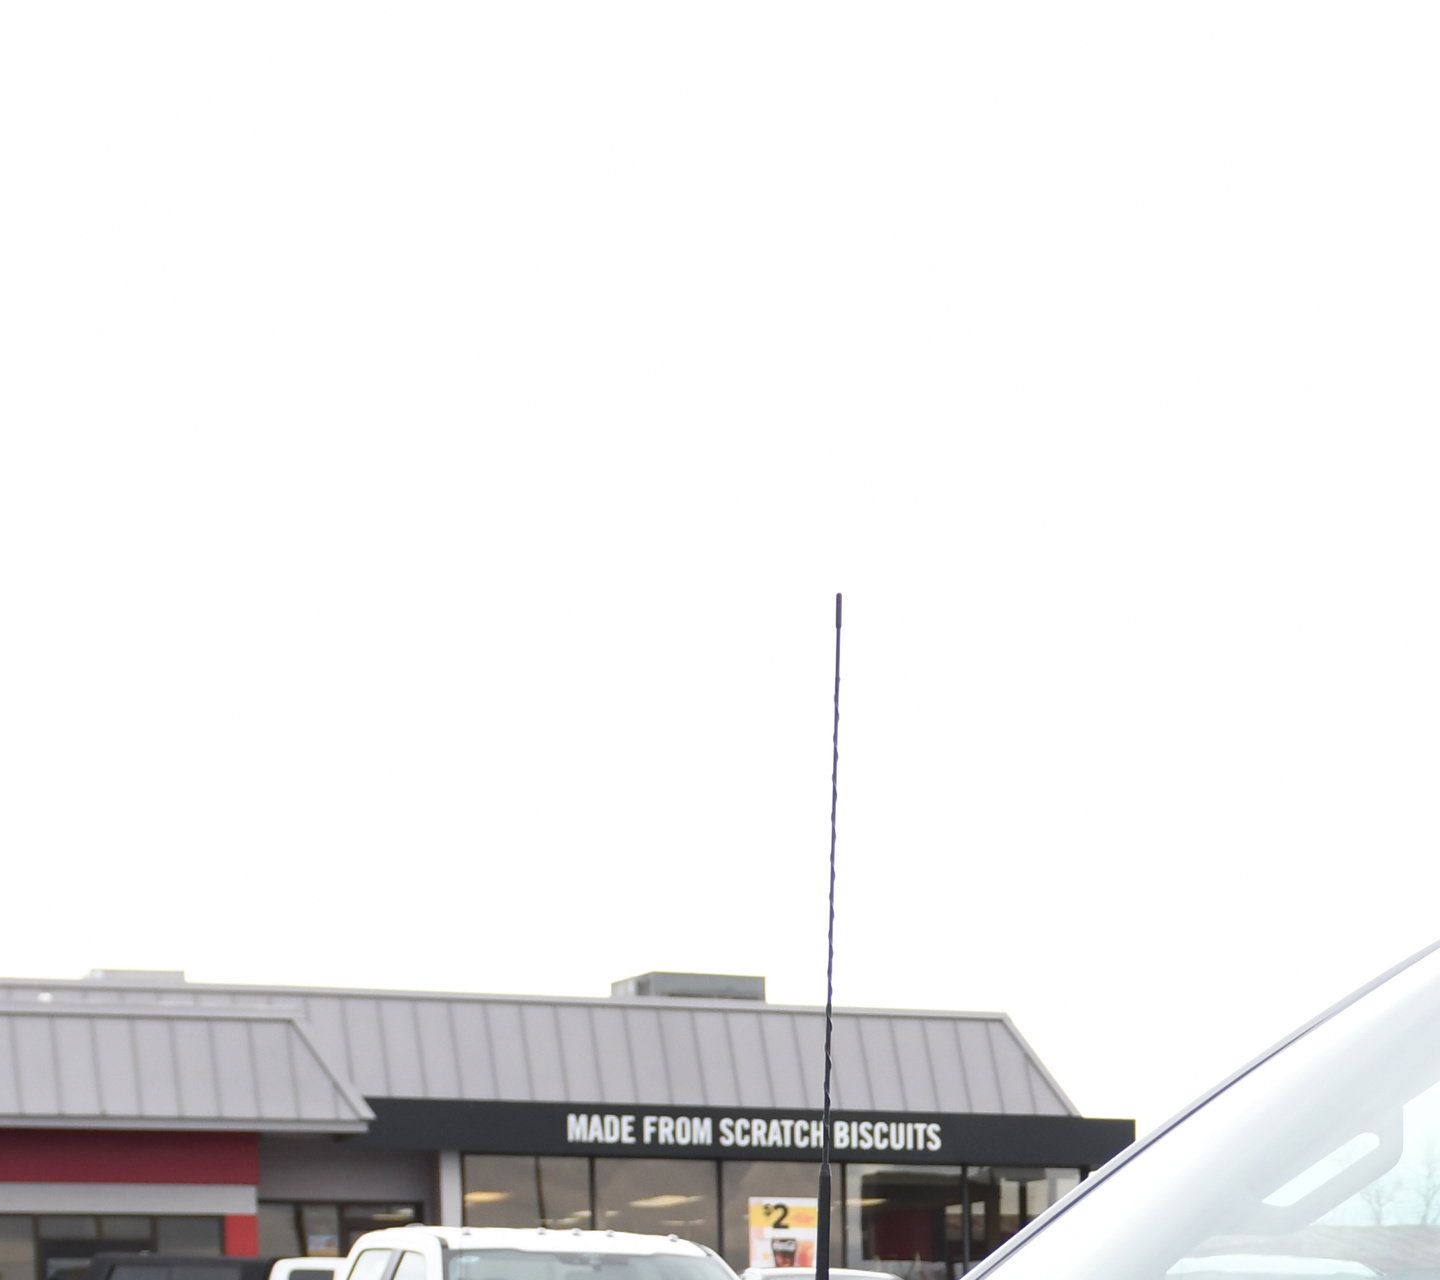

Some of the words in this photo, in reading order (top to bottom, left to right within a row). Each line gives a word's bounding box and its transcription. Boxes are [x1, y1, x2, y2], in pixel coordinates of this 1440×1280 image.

[566, 1113, 636, 1144] MADE
[642, 1115, 713, 1146] FROM
[718, 1117, 824, 1148] SCRATCH
[833, 1121, 942, 1151] BISCUITS
[763, 1203, 789, 1229] $2
